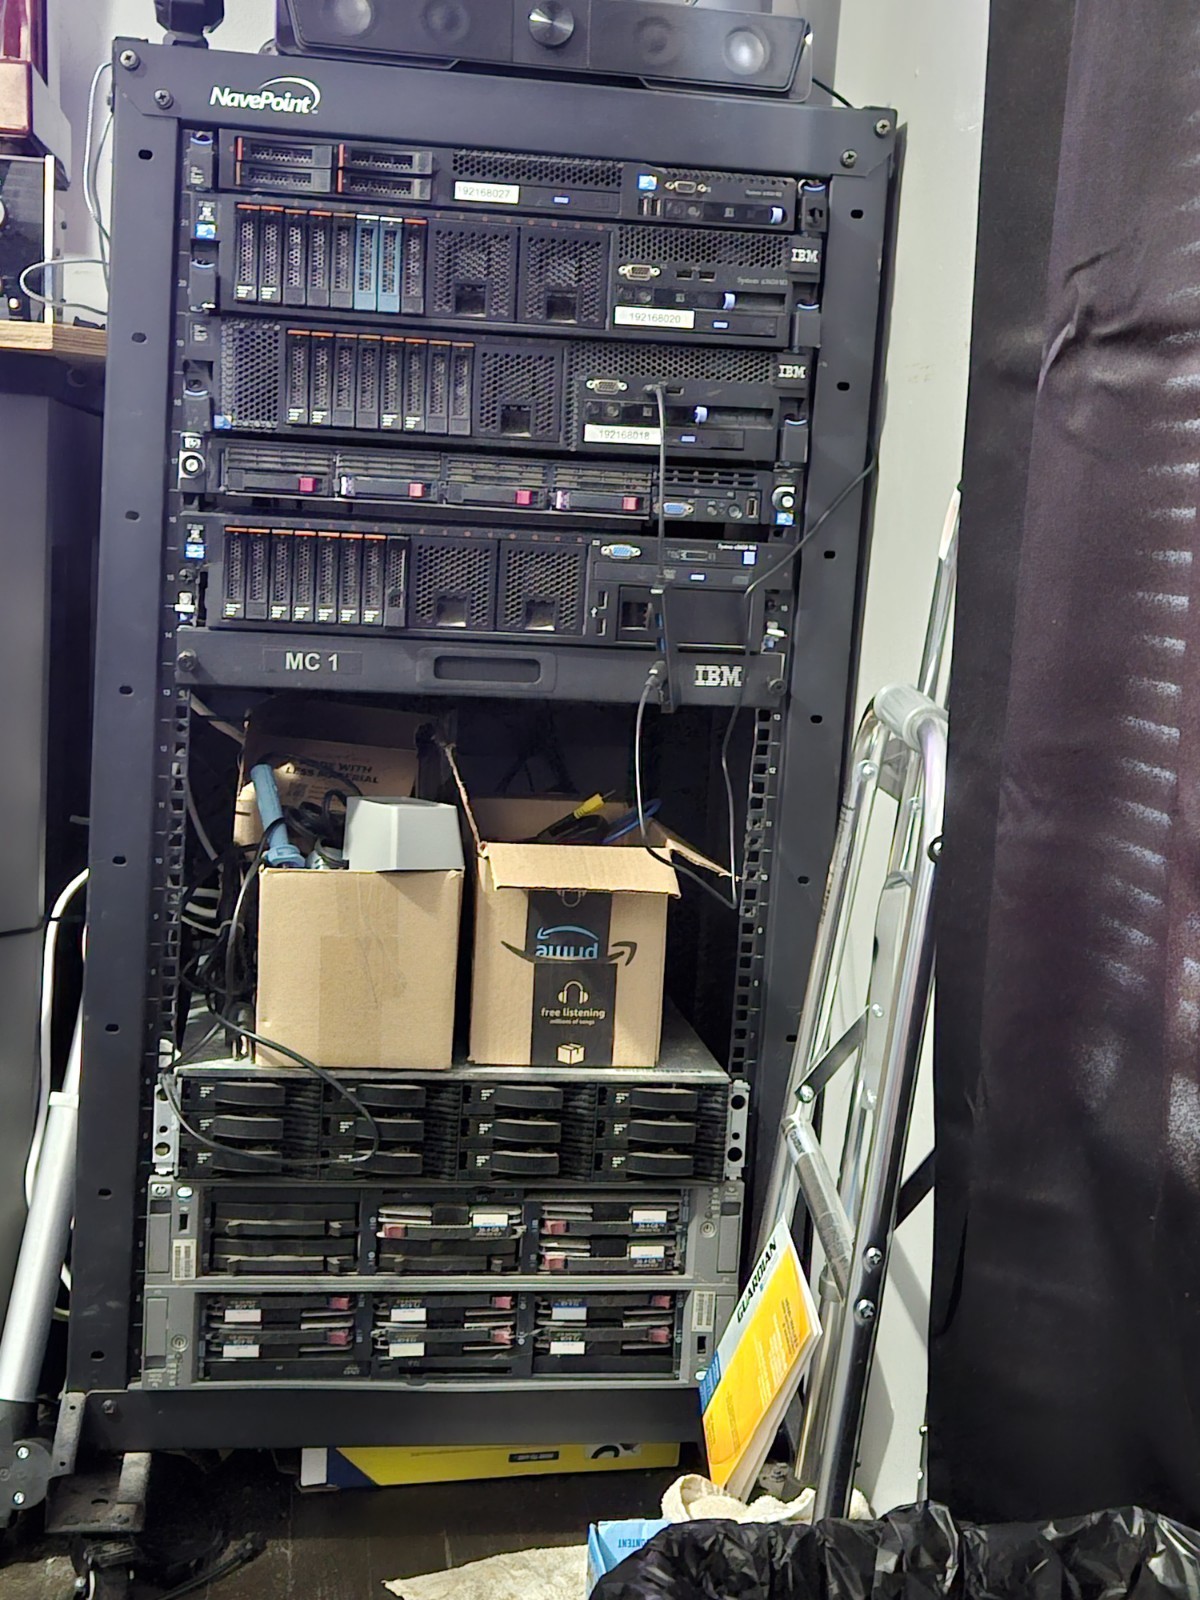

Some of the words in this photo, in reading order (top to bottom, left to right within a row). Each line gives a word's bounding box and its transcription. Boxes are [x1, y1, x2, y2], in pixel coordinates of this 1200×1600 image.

[209, 86, 313, 114] NavePoint
[457, 186, 511, 199] 192168027
[791, 248, 819, 263] IBM
[629, 312, 682, 324] 192168020
[778, 364, 806, 379] IBM
[599, 429, 650, 441] 192168018
[285, 651, 321, 671] MC
[328, 653, 338, 672] 1
[694, 664, 743, 687] IBM
[338, 762, 375, 774] WITH
[535, 943, 599, 960] prime
[541, 1007, 562, 1017] free
[563, 1007, 606, 1020] listening
[737, 1237, 778, 1324] GUARDIAN
